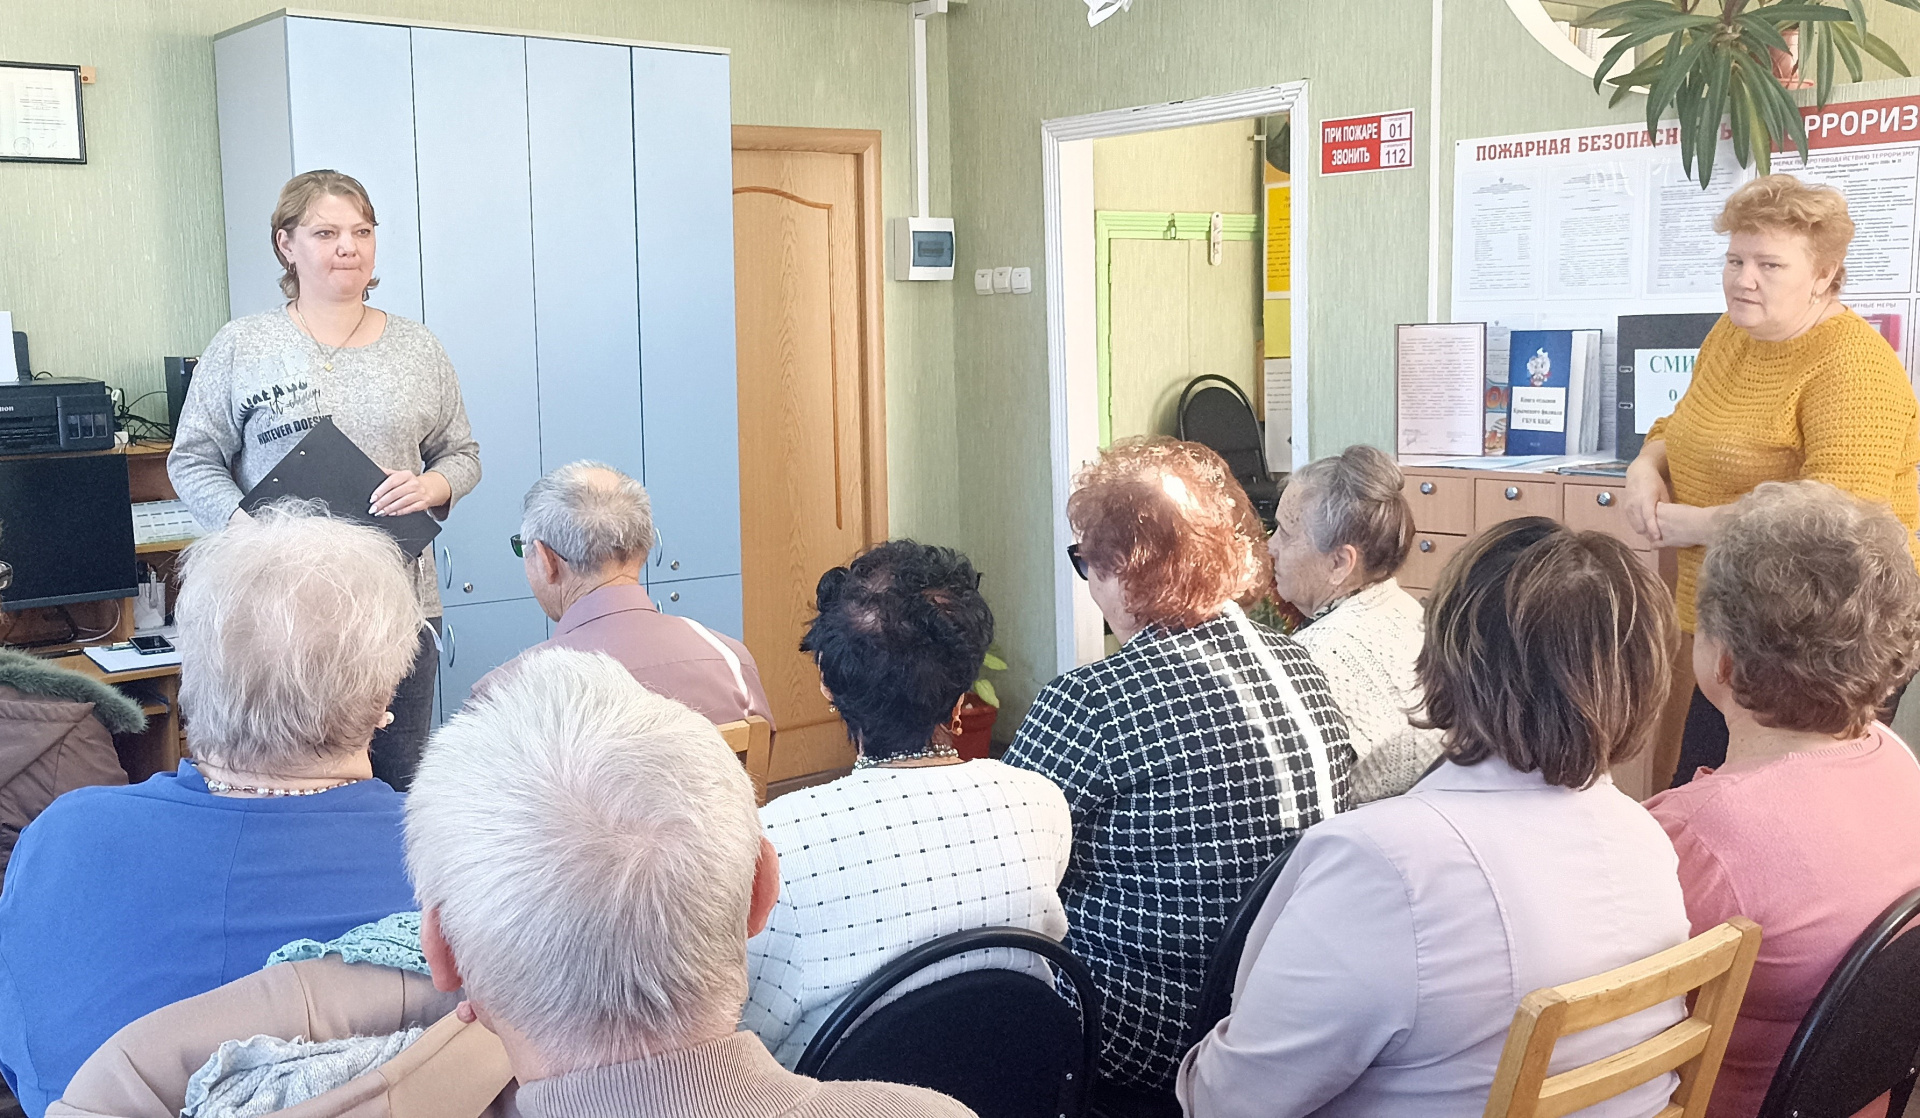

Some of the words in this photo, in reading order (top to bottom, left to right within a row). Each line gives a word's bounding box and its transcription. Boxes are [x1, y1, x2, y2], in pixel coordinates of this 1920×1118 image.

[1390, 122, 1402, 138] 01
[1787, 104, 1919, 141] РРОРИЗ
[1324, 127, 1342, 143] ПРИ
[1343, 122, 1378, 142] ПОЖАРЕ
[1476, 138, 1571, 161] ПОЖАРНАЯ
[1578, 123, 1733, 153] БЕЗОПАСНЬ
[1331, 147, 1370, 166] ЗВОНИТЬ
[1385, 148, 1406, 164] 112
[1649, 355, 1695, 373] СМИ
